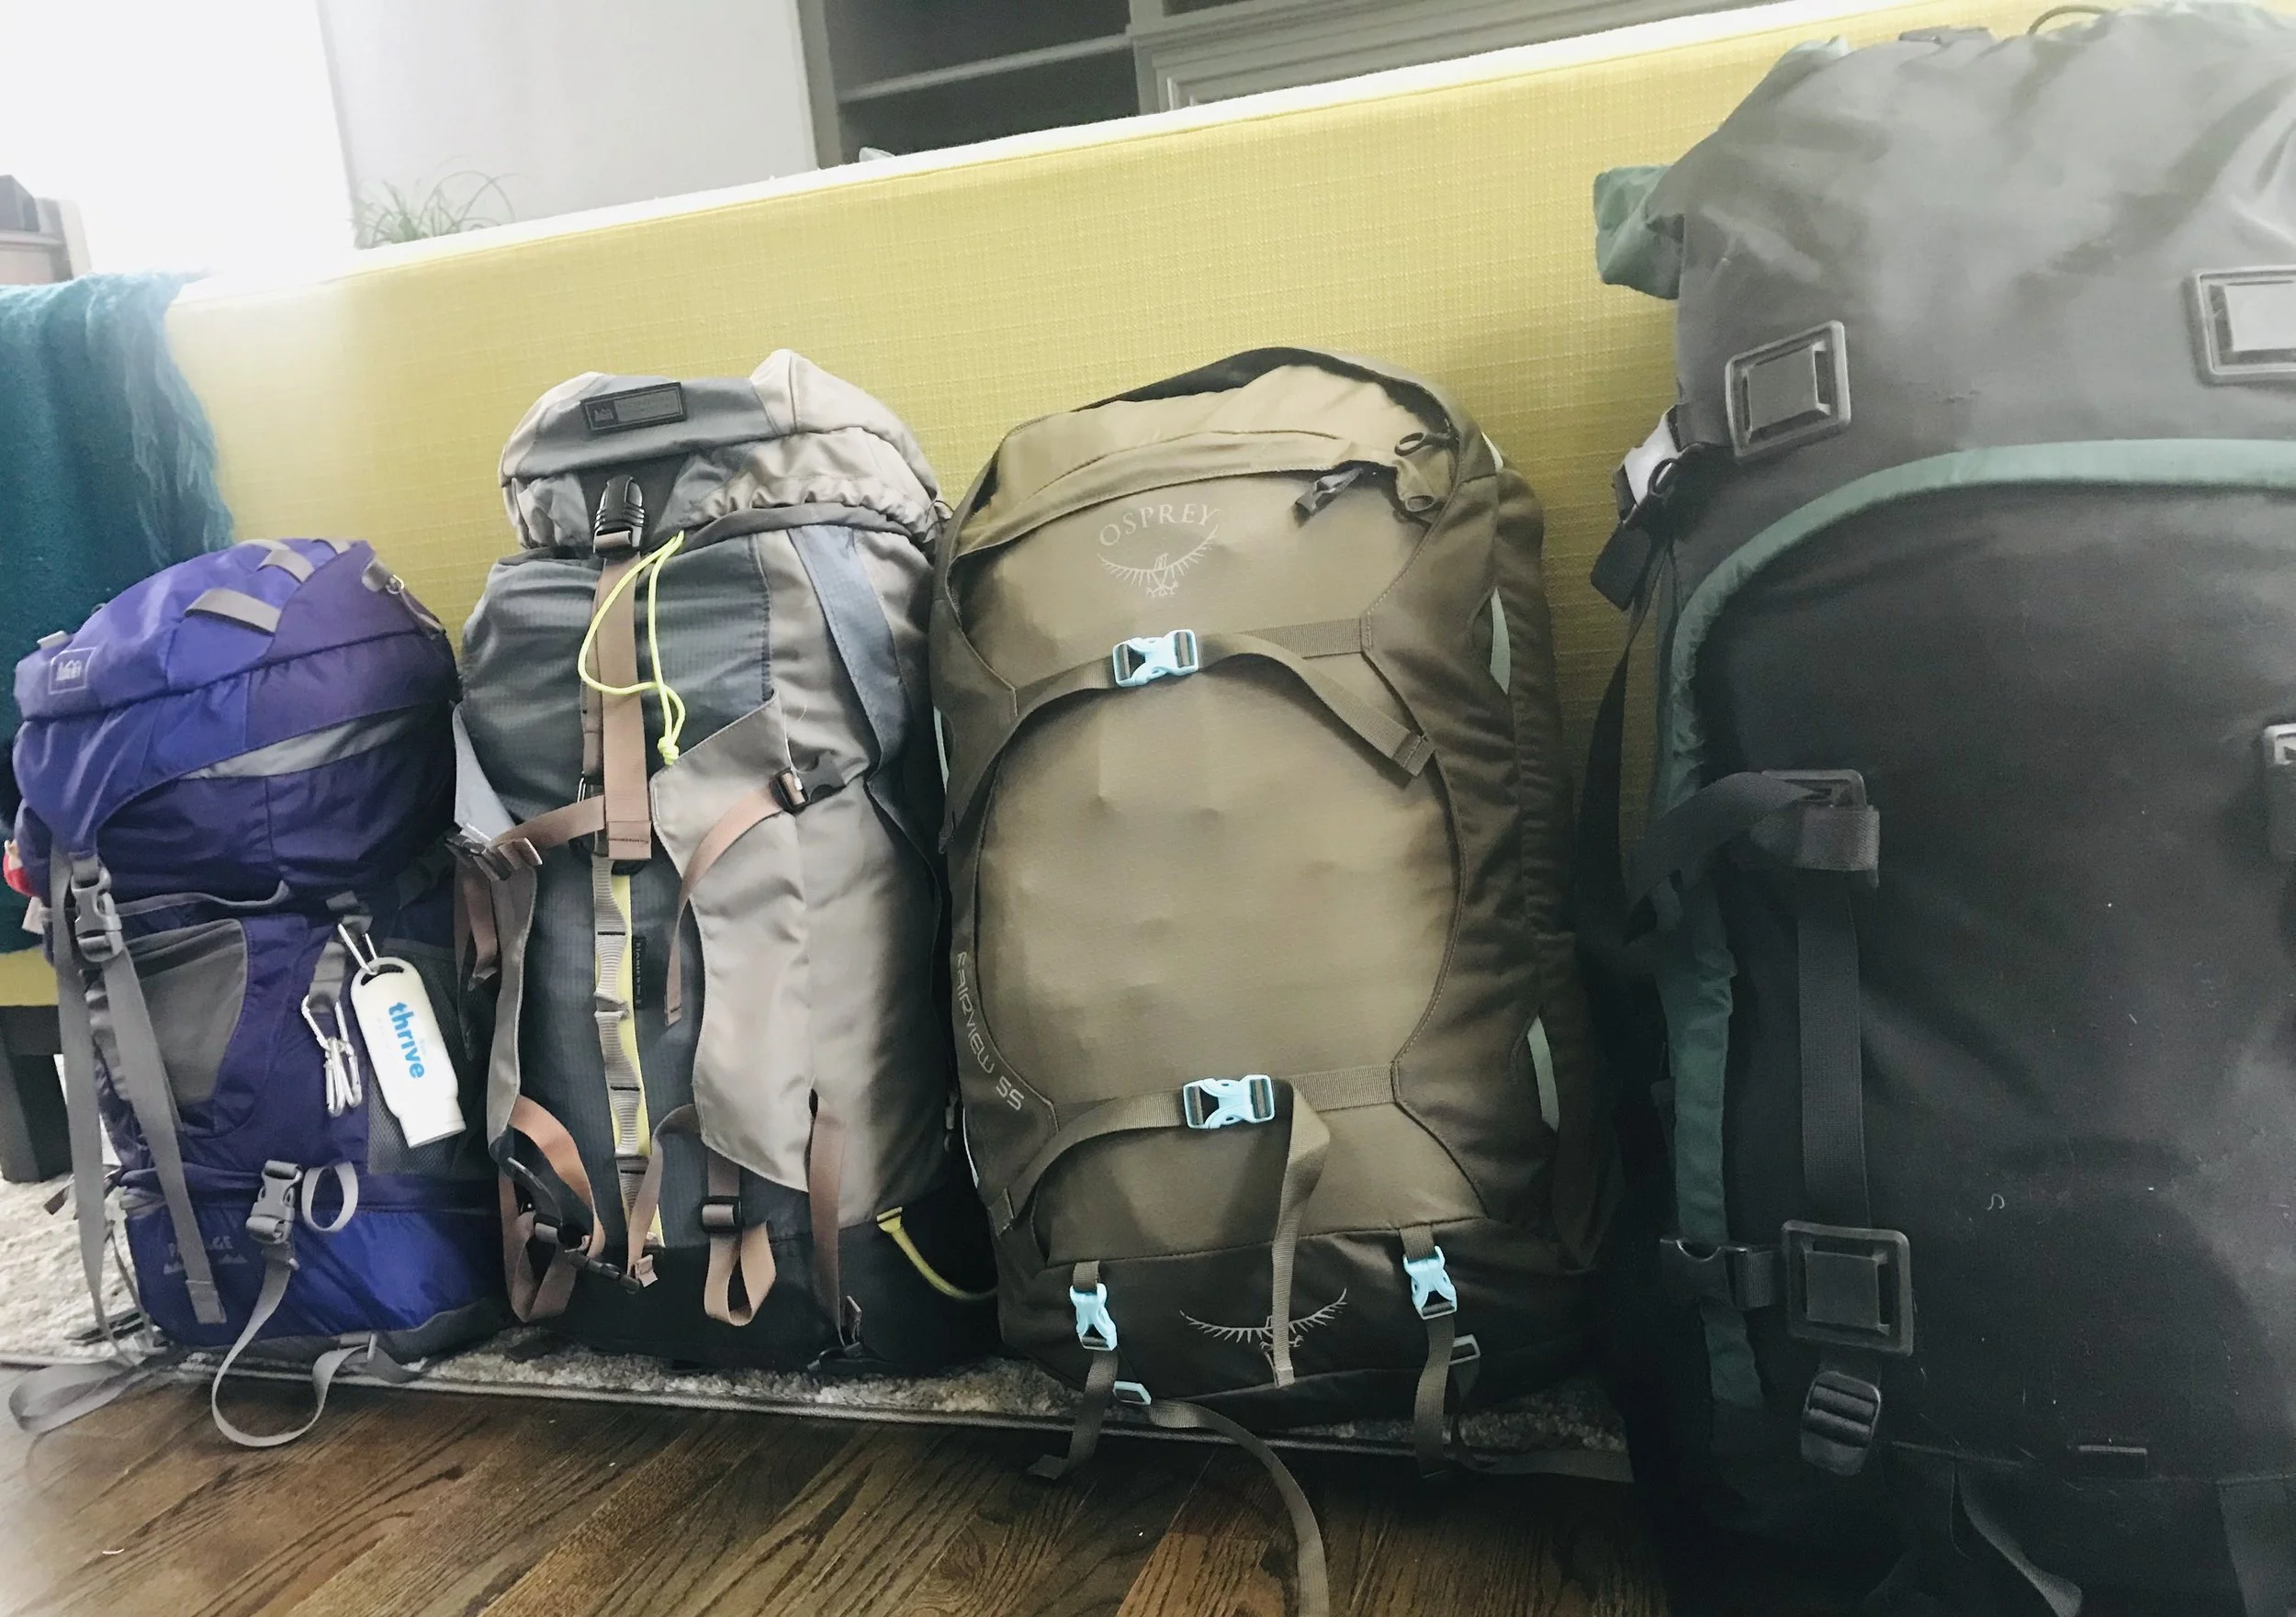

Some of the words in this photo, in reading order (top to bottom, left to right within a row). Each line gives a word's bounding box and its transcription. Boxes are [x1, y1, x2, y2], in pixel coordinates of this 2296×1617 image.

[1099, 504, 1220, 546] OSPREY
[388, 1002, 425, 1079] thrive
[957, 951, 995, 1073] FAIRVIEW
[996, 1075, 1025, 1111] 55
